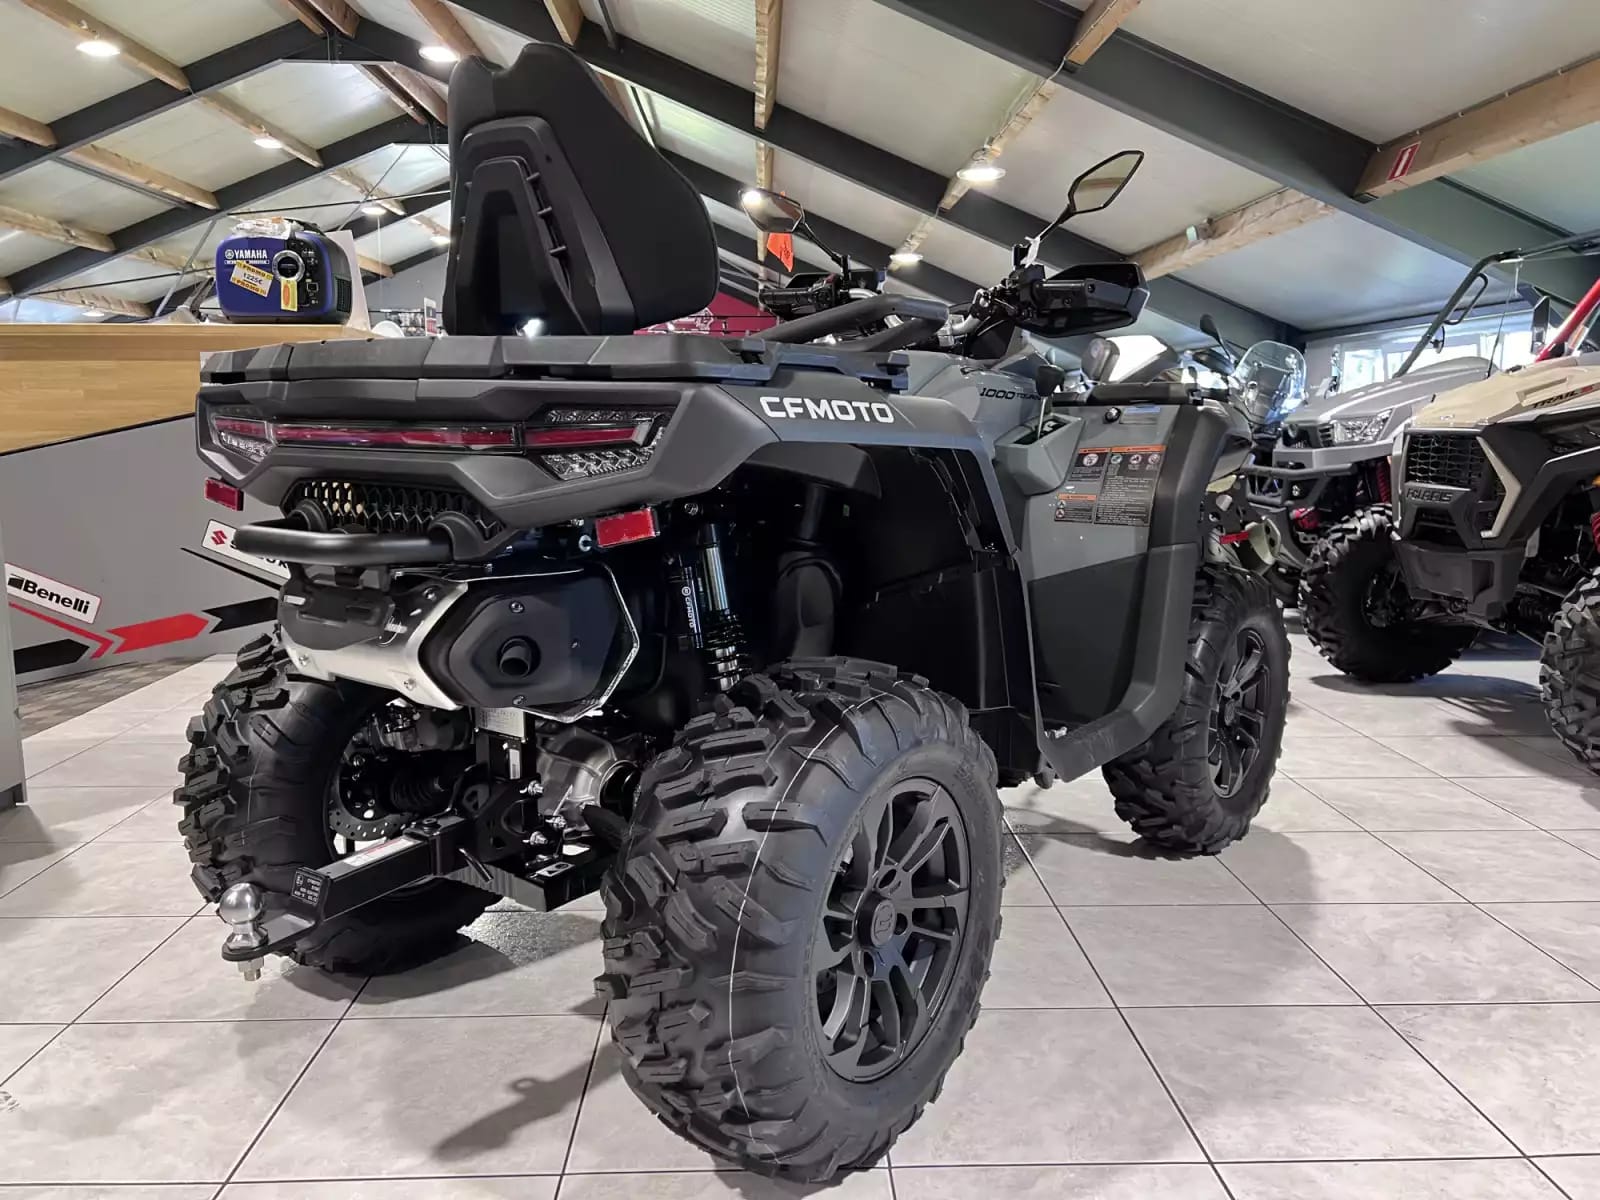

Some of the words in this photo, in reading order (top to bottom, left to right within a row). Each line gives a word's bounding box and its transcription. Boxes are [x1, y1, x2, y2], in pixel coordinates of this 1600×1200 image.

[234, 249, 267, 259] YAMAHA
[980, 387, 1016, 400] 1000
[1533, 390, 1578, 408] TRAIL
[759, 396, 895, 423] CFMOTO
[22, 579, 91, 615] Benelli
